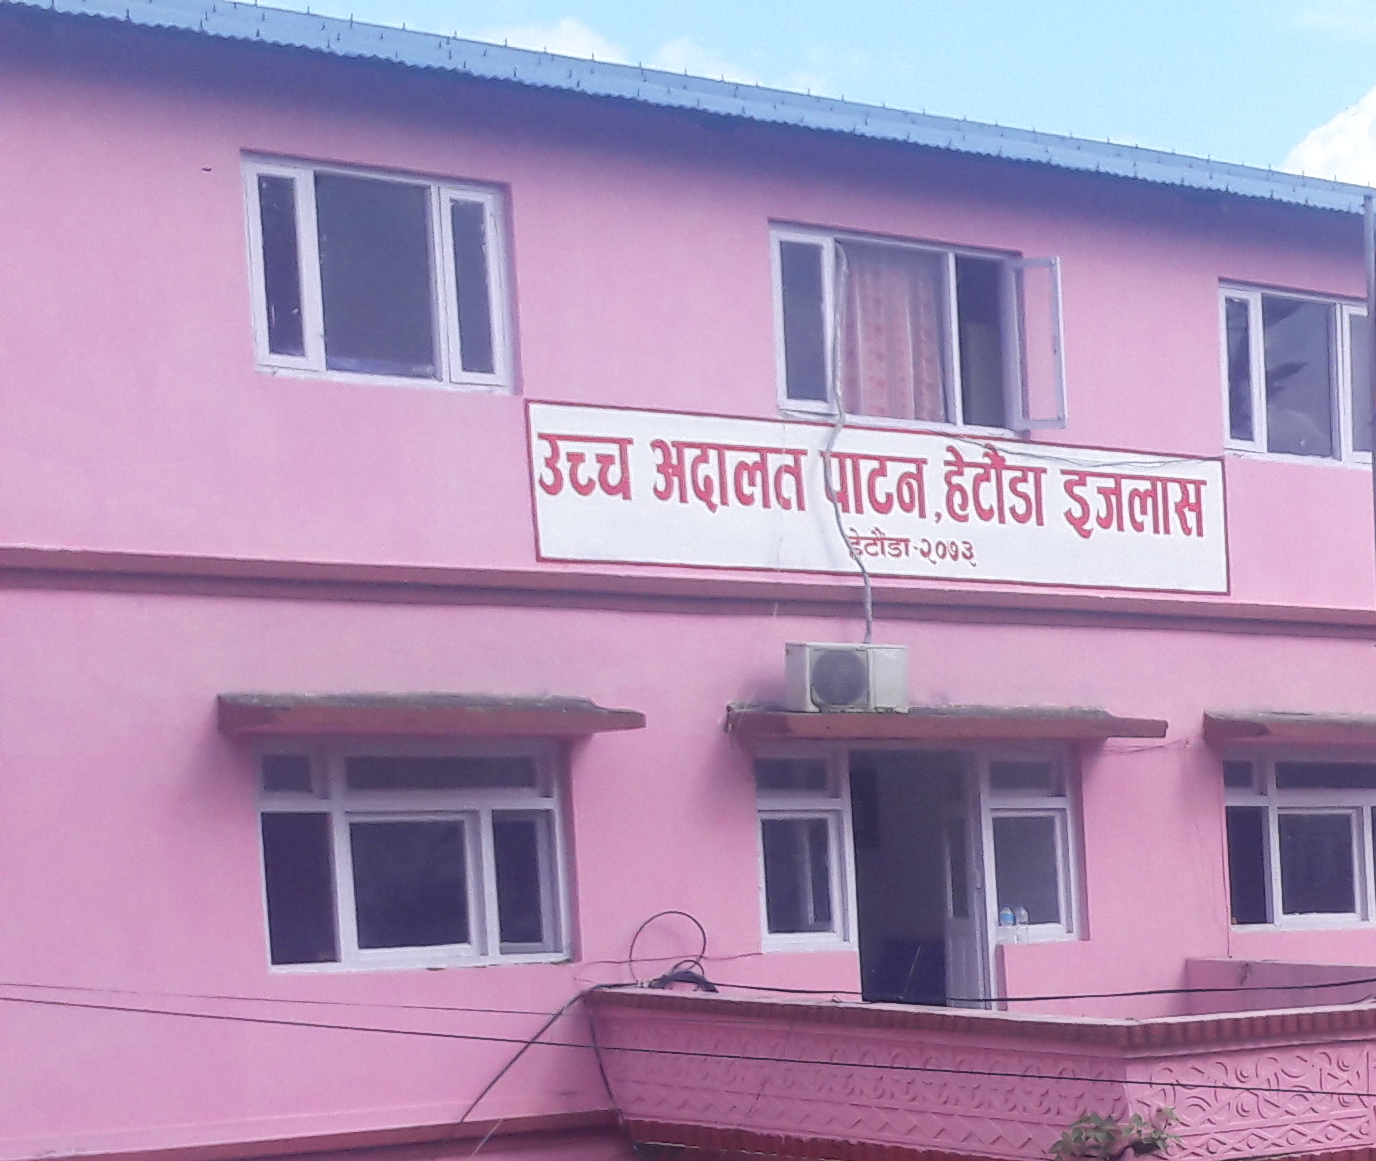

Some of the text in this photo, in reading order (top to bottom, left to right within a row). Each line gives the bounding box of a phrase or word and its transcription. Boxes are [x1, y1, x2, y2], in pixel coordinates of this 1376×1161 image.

[537, 432, 634, 501] उच्च
[650, 438, 808, 513] अदालत
[1060, 469, 1207, 539] इजलास
